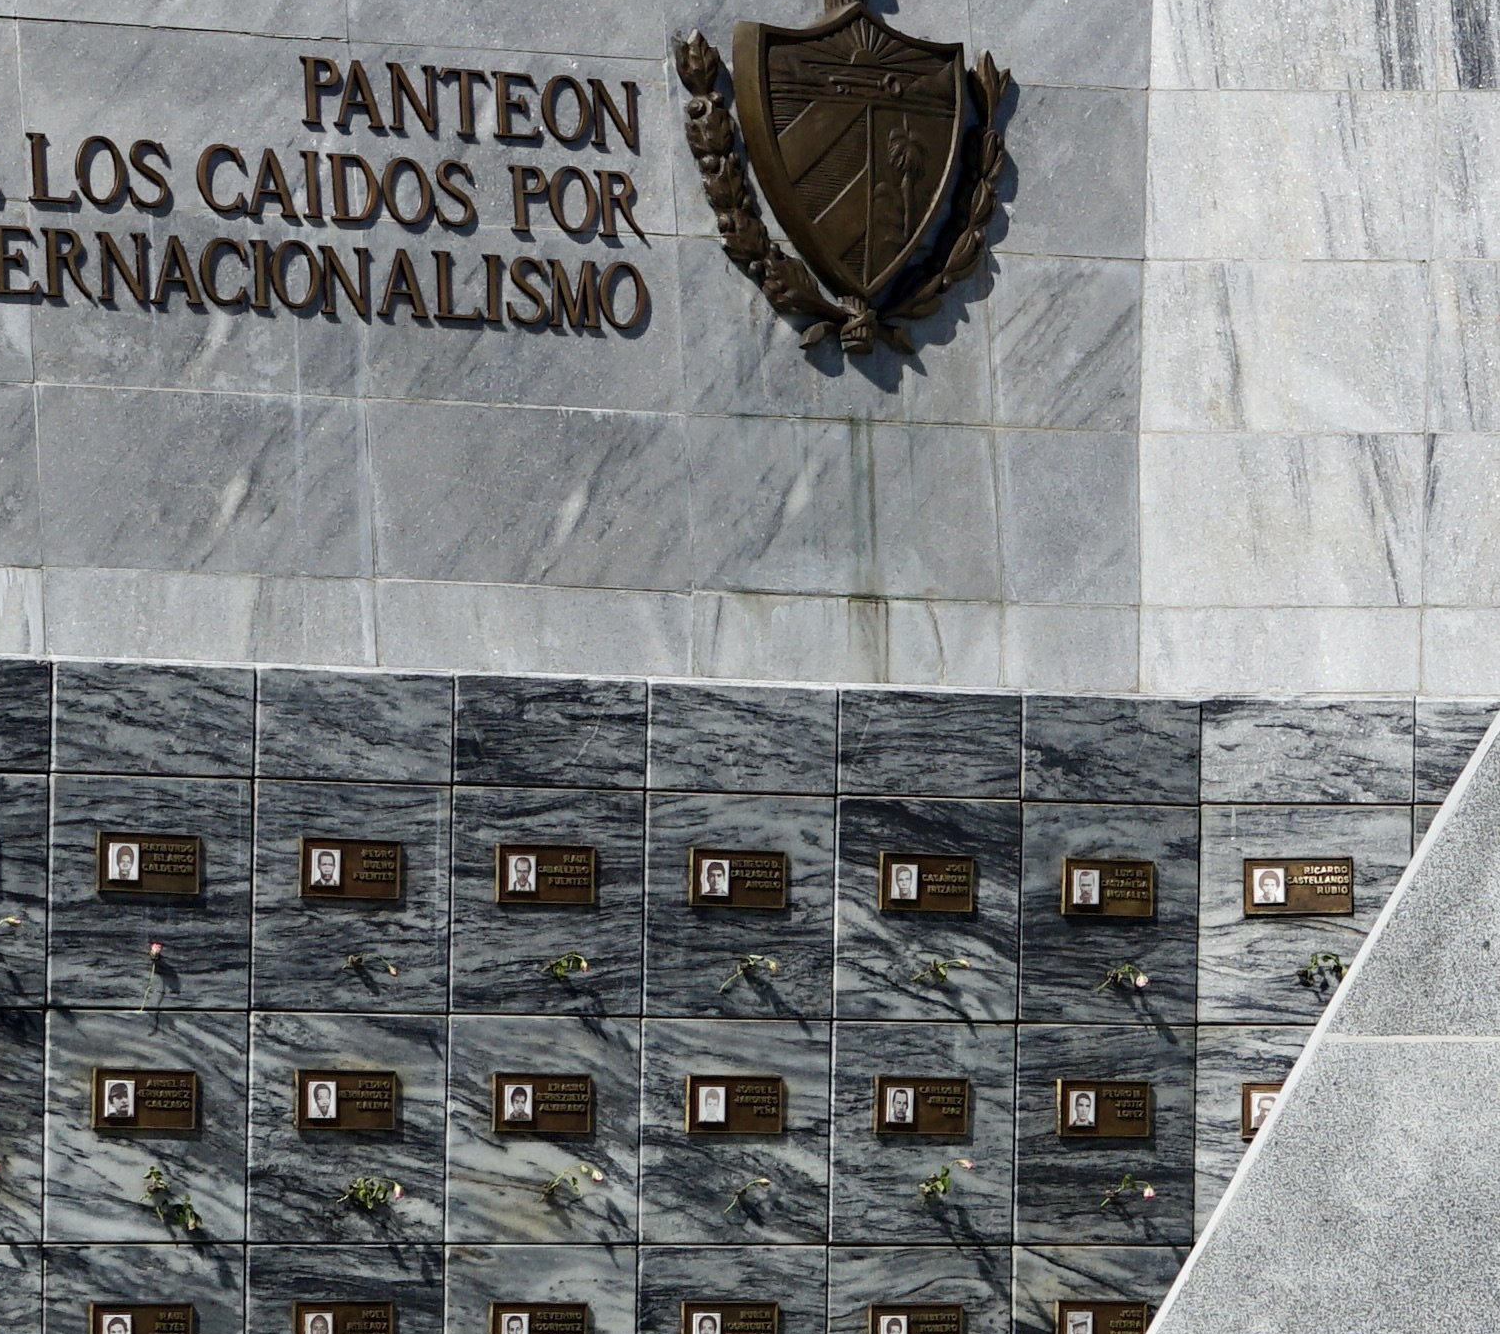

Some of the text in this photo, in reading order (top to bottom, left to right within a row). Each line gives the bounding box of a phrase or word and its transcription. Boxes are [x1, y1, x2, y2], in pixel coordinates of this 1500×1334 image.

[299, 55, 636, 149] PANTEON
[25, 131, 172, 210] LOS
[196, 143, 476, 227] CAIDOS
[508, 164, 647, 241] POR
[141, 842, 194, 852] RAYMUNDO
[154, 853, 194, 863] BLANCO
[360, 849, 395, 858] PEDRO
[141, 863, 194, 873] CALDERON
[1304, 866, 1348, 875] RICARDO
[353, 871, 395, 881] FUENTES
[1286, 875, 1350, 885] CASTELLANOS
[1316, 886, 1349, 895] RUBIO
